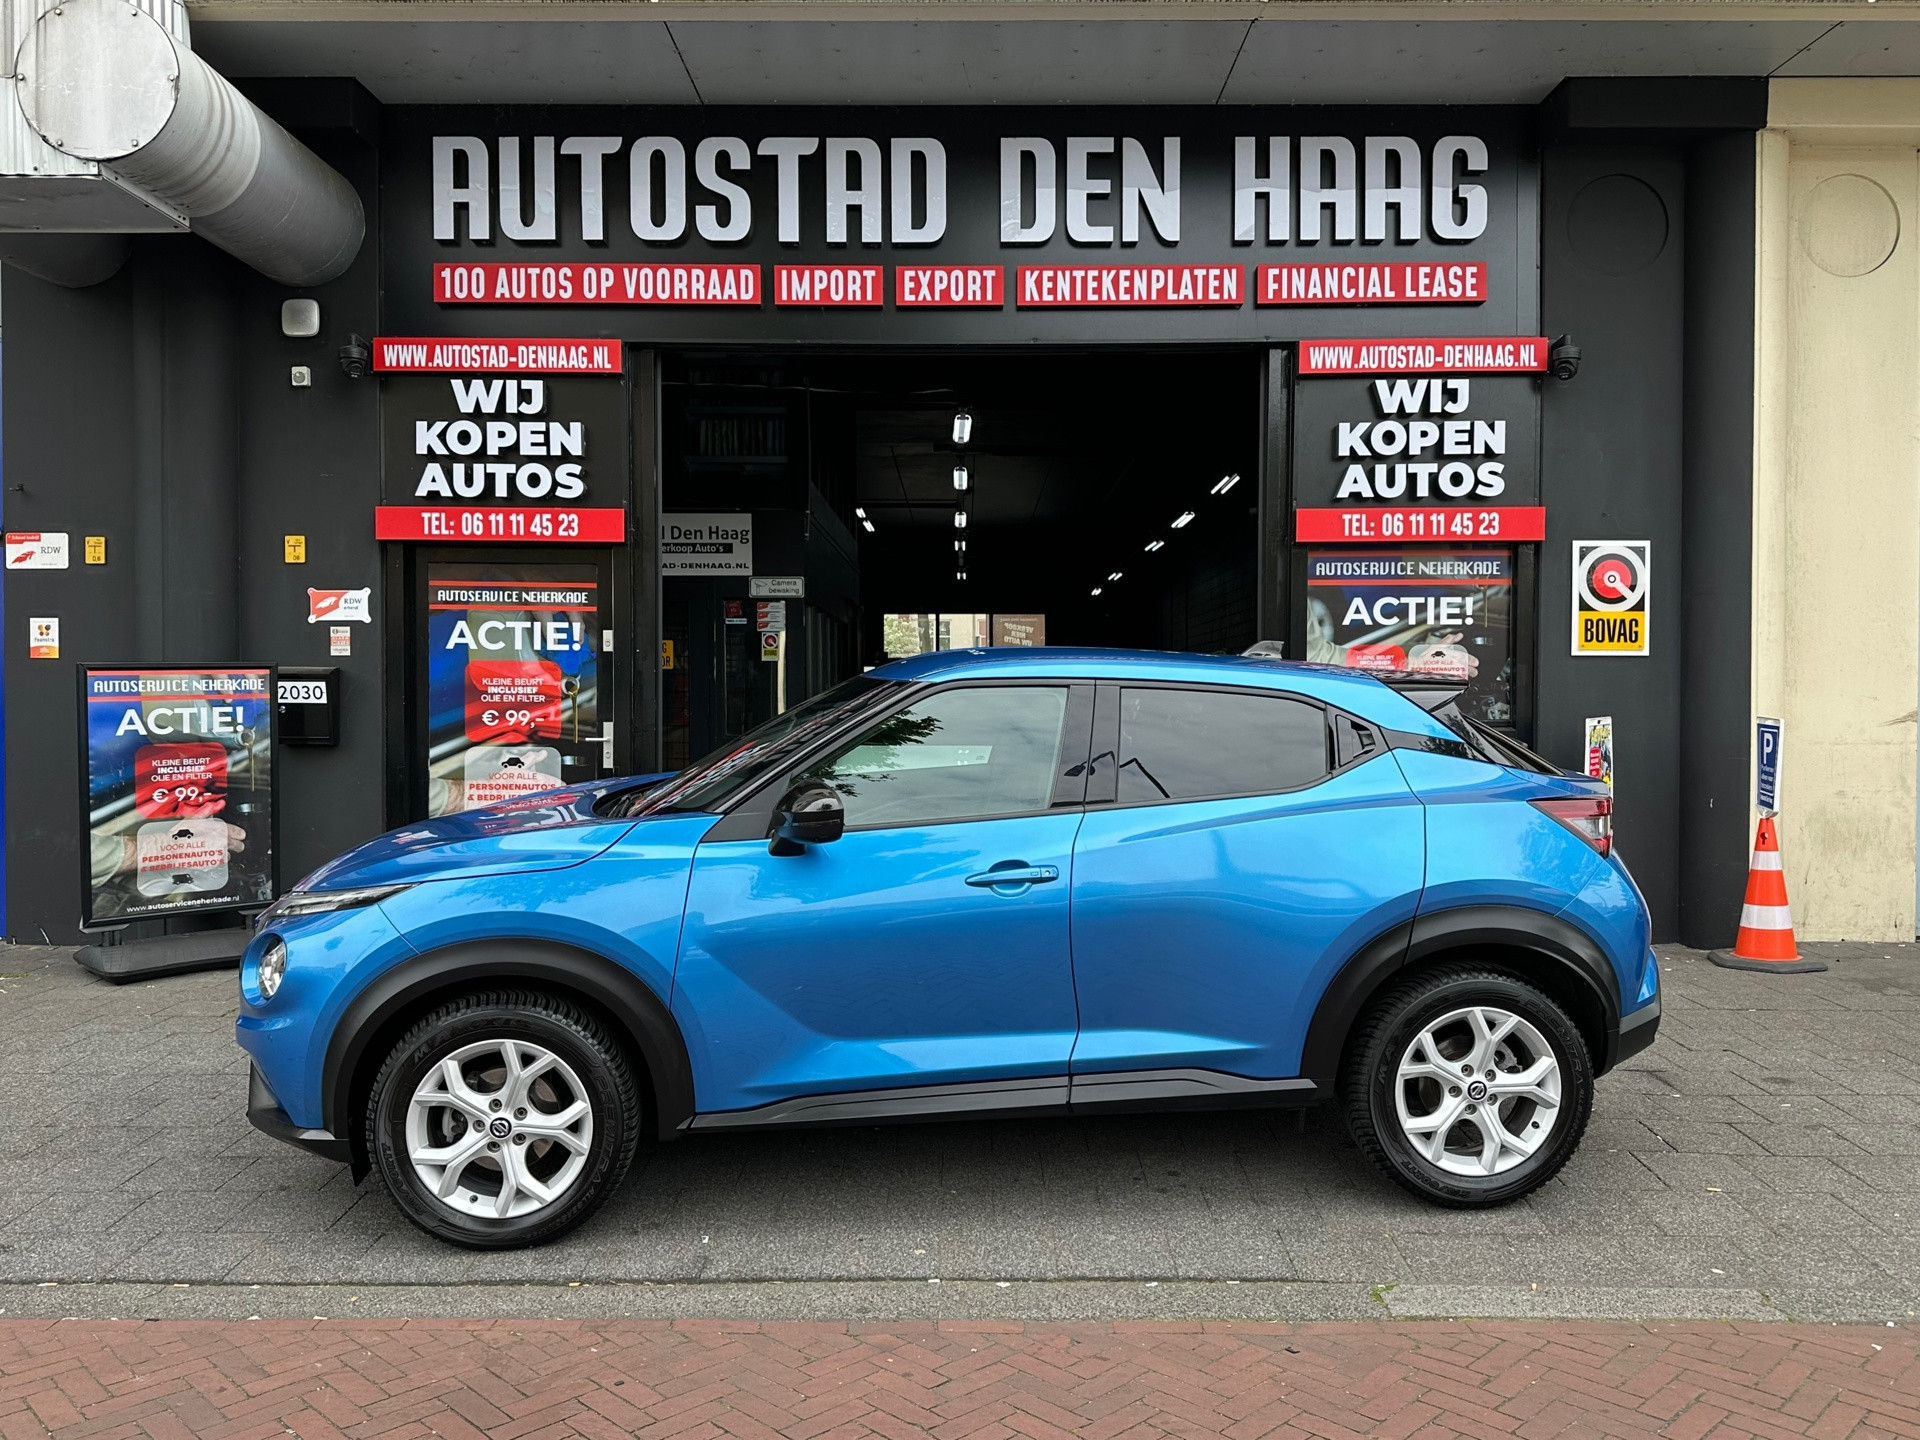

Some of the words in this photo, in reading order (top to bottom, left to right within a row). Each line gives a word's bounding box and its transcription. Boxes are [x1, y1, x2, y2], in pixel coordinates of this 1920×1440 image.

[431, 135, 950, 246] AUTOSTAD
[1000, 135, 1181, 245] DEN
[1233, 135, 1489, 245] HAAG
[440, 268, 484, 302] 100
[494, 267, 574, 301] AUTOS
[583, 267, 615, 300] OP
[623, 267, 756, 301] VOORRAAD
[782, 269, 877, 302] IMPORT
[902, 269, 998, 302] EXPORT
[1024, 268, 1239, 302] KENTEKENPLATEN
[1265, 267, 1395, 300] FINANCIAL
[1404, 267, 1479, 299] LEASE
[384, 343, 612, 369] WWW.AUTOSTAD-DENHAAG.NL
[1310, 343, 1537, 370] WWW.AUTOSTAD-DENHAAG.NL
[450, 379, 544, 415] WIJ
[1374, 379, 1470, 414] WIJ
[415, 421, 584, 456] KOPEN
[1337, 420, 1506, 456] KOPEN
[415, 462, 586, 499] AUTOS
[1336, 462, 1505, 499] AUTOS
[421, 513, 455, 537] TEL:
[461, 513, 486, 537] 06
[490, 513, 507, 536] 11
[511, 513, 526, 536] 11
[530, 513, 553, 536] 45
[558, 513, 579, 536] 23
[1342, 513, 1376, 536] TEL:
[1381, 513, 1404, 536] 06
[1408, 513, 1425, 536] 11
[1430, 513, 1445, 536] 11
[1450, 513, 1474, 535] 45
[1478, 513, 1500, 535] 23
[671, 526, 704, 540] Den
[709, 526, 750, 544] Haag
[40, 546, 62, 554] RDW
[662, 544, 694, 554] erkoop
[695, 544, 724, 553] Auto's
[662, 562, 750, 570] AD-DENHAAG.NL
[1315, 562, 1415, 576] AUTOSERVICE
[1418, 561, 1501, 576] NEHERKADE
[438, 590, 519, 602] AUTOSERVICE
[522, 591, 589, 603] NEHERKADE
[768, 587, 800, 595] bewaking
[343, 597, 362, 605] RDW
[1342, 596, 1475, 626] ACTIE!
[446, 621, 582, 651] ACTIE!
[1583, 618, 1640, 644] BOVAG
[94, 680, 189, 693] AUTOSERVICE
[192, 678, 265, 691] NEHERKADE
[482, 678, 513, 686] KLEINE
[514, 678, 545, 686] BEURT
[487, 686, 539, 694] INCLUSIEF
[278, 685, 325, 700] 2030
[480, 694, 502, 703] OLIE
[503, 694, 516, 702] EN
[517, 694, 546, 703] FILTER
[116, 706, 244, 736] ACTIE!
[481, 710, 500, 724] €
[505, 709, 545, 728] 99,-
[1763, 732, 1773, 764] P
[152, 758, 181, 766] KLEINE
[182, 757, 210, 766] BEURT
[157, 765, 206, 773] INCLUSIEF
[150, 773, 172, 781] OLIE
[172, 773, 184, 781] EN
[185, 772, 213, 780] FILTER
[488, 773, 515, 781] VOOR
[152, 789, 169, 803] €
[174, 786, 213, 803] 99,-
[468, 783, 556, 792] PERSONENAUTO'S
[142, 849, 224, 863] PERSONENAUTO'S
[160, 843, 184, 852] VOOR
[185, 841, 206, 850] ALLE
[141, 864, 148, 872] &
[149, 858, 225, 872] BEDRIJFSAUTO'S
[126, 894, 240, 914] www.autoserviceneherkade.nl
